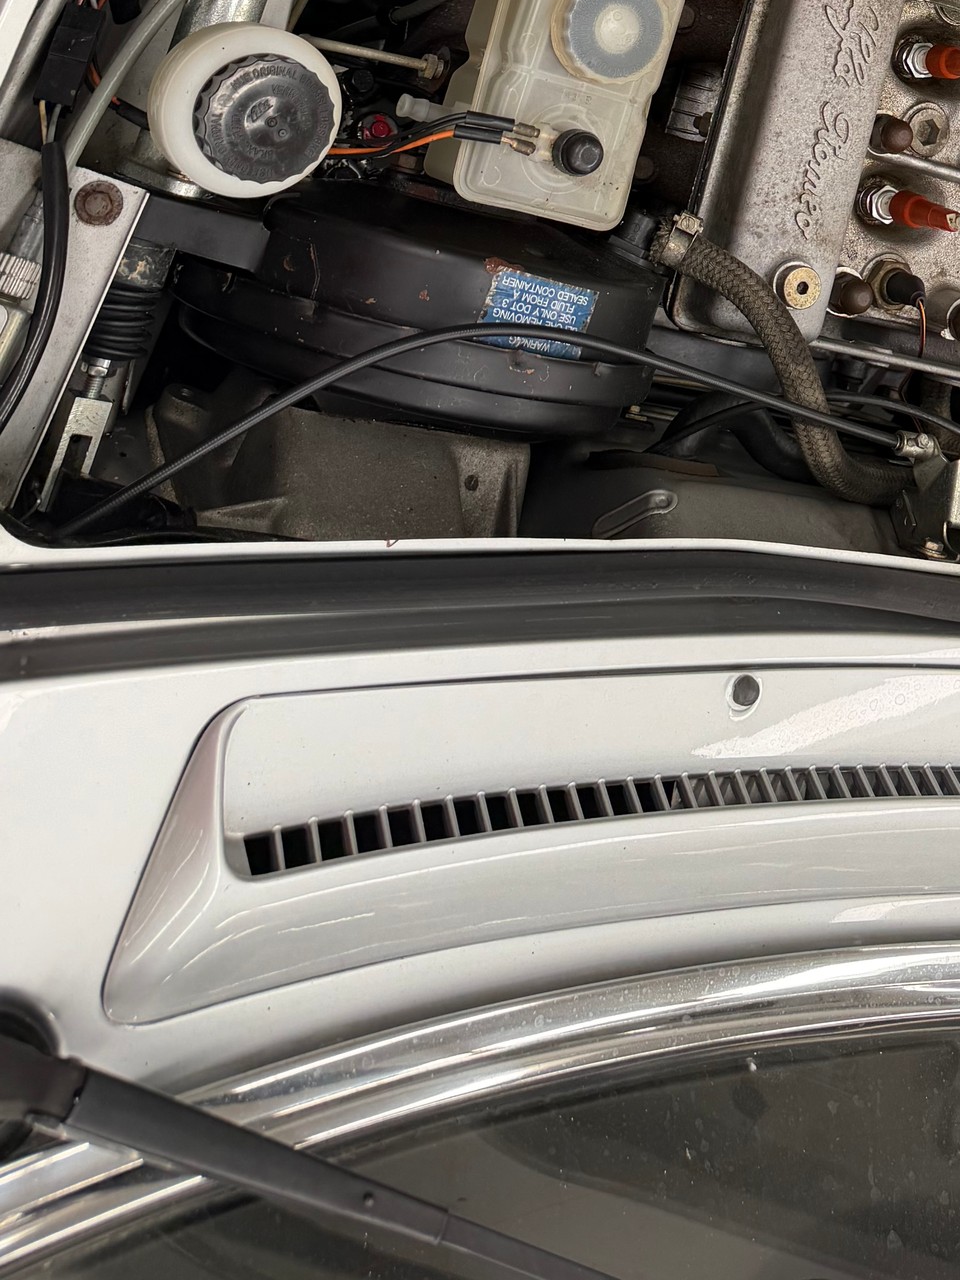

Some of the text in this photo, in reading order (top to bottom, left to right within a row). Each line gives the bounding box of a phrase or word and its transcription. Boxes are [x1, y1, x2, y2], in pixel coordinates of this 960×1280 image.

[253, 66, 298, 79] ORIGINAL
[794, 101, 850, 240] Romeo
[502, 276, 588, 305] SEALED CONTAINER
[513, 289, 574, 312] FLUID FROM A
[493, 308, 542, 324] REMOVING
[501, 298, 576, 323] USE ONLY DOT 3
